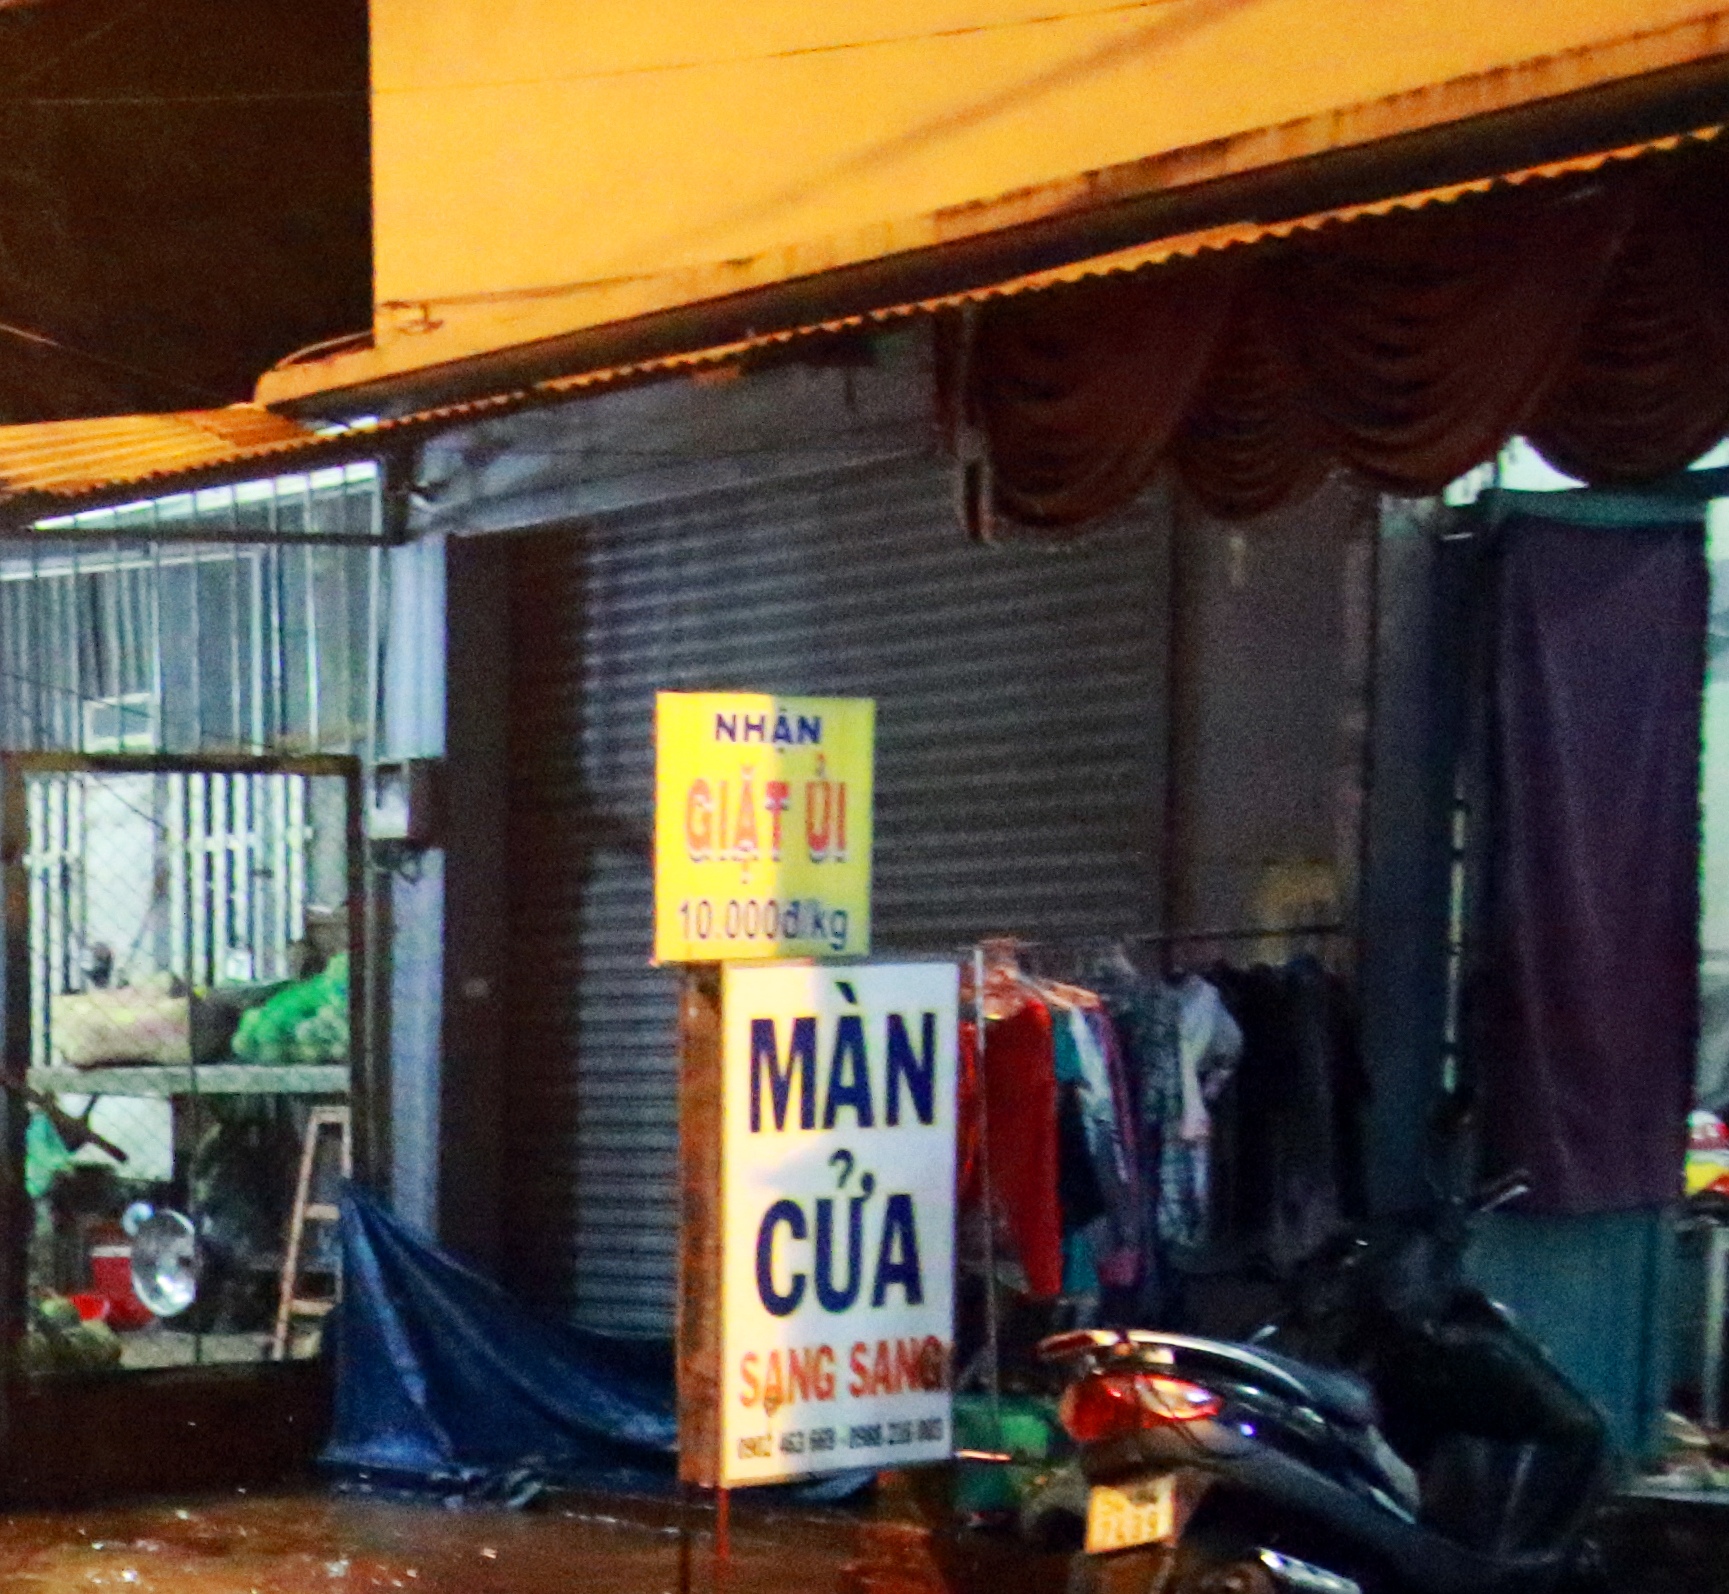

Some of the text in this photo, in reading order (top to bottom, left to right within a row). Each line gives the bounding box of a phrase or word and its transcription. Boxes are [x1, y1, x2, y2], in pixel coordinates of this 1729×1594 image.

[714, 706, 822, 755] NHẬN
[749, 981, 937, 1133] MÀN
[755, 1149, 925, 1318] CỬA
